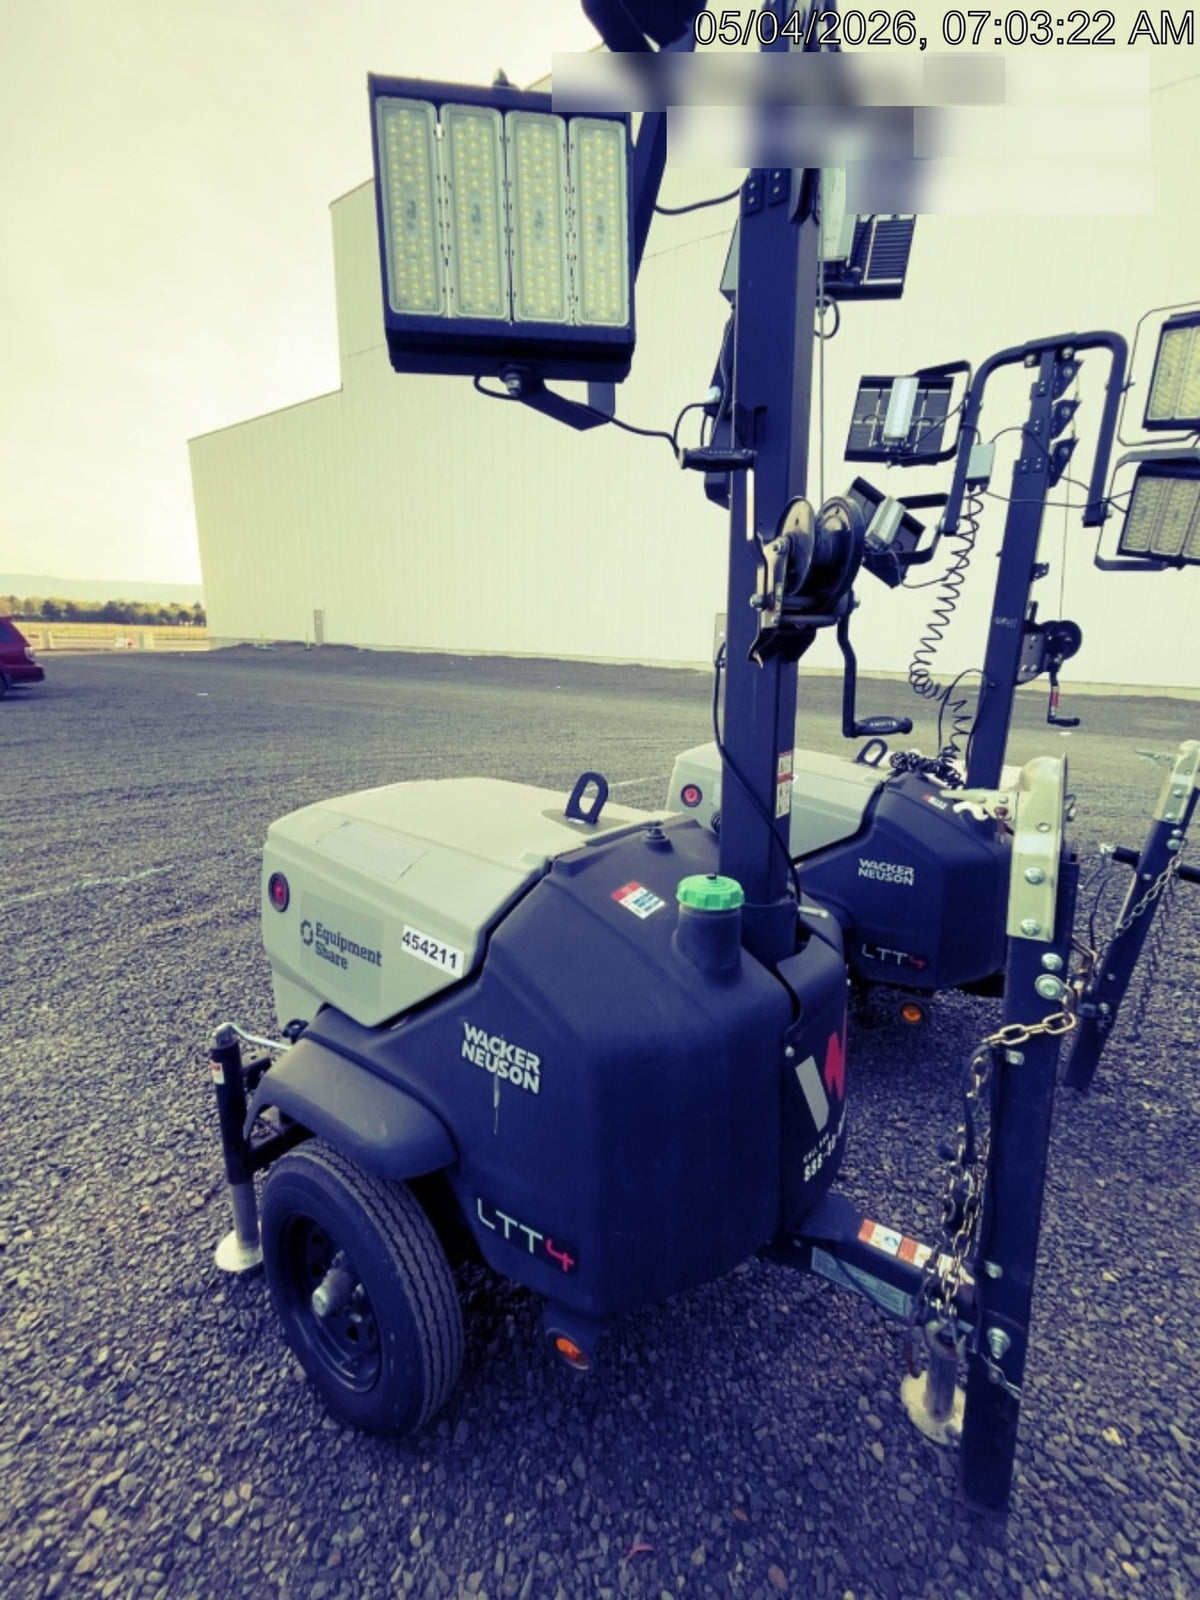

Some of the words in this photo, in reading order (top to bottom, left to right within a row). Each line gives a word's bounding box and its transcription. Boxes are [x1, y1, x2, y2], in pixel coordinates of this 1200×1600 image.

[858, 858, 915, 877] WACKER
[858, 867, 915, 886] NEUSON
[314, 941, 349, 970] Share
[315, 922, 383, 967] Equipment
[402, 931, 458, 969] 454211
[861, 943, 927, 970] LTT4
[461, 1040, 540, 1094] NEUSON
[463, 1021, 541, 1075] WACKER
[476, 1197, 575, 1272] LTT4
